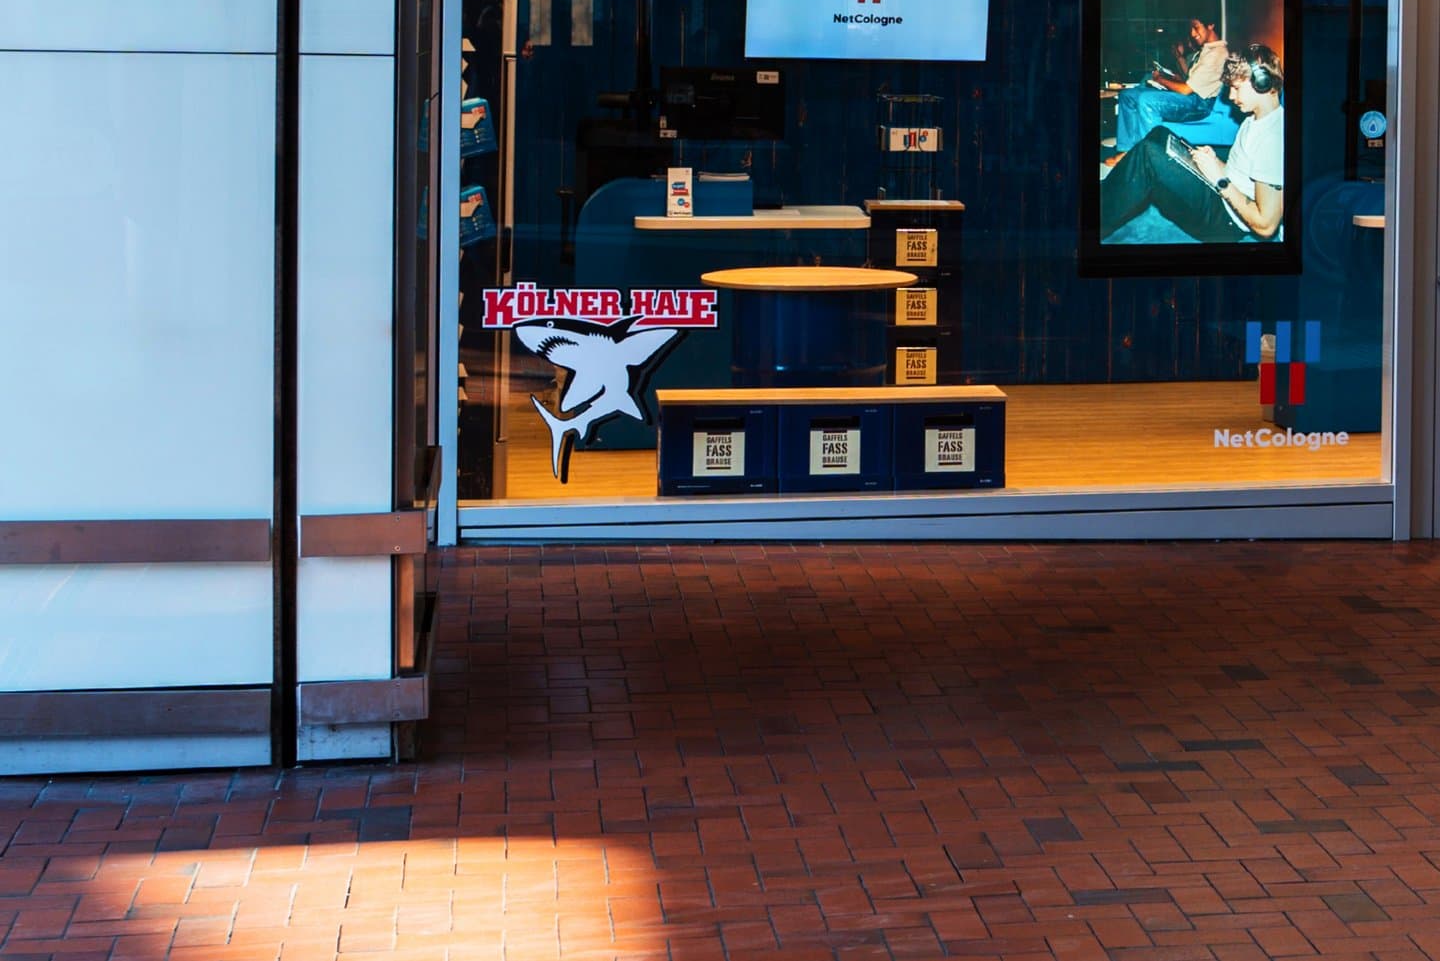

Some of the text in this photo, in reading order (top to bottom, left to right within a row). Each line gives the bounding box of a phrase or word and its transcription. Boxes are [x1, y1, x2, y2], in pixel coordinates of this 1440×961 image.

[833, 13, 903, 27] NetCologne
[907, 241, 928, 251] FASS
[483, 282, 717, 327] KÖLNER HAIE
[906, 300, 927, 310] FASS
[906, 359, 927, 369] FASS
[1214, 427, 1349, 451] NetCologne
[706, 444, 732, 457] FASS
[822, 442, 848, 455] FASS
[937, 440, 963, 453] FASS
